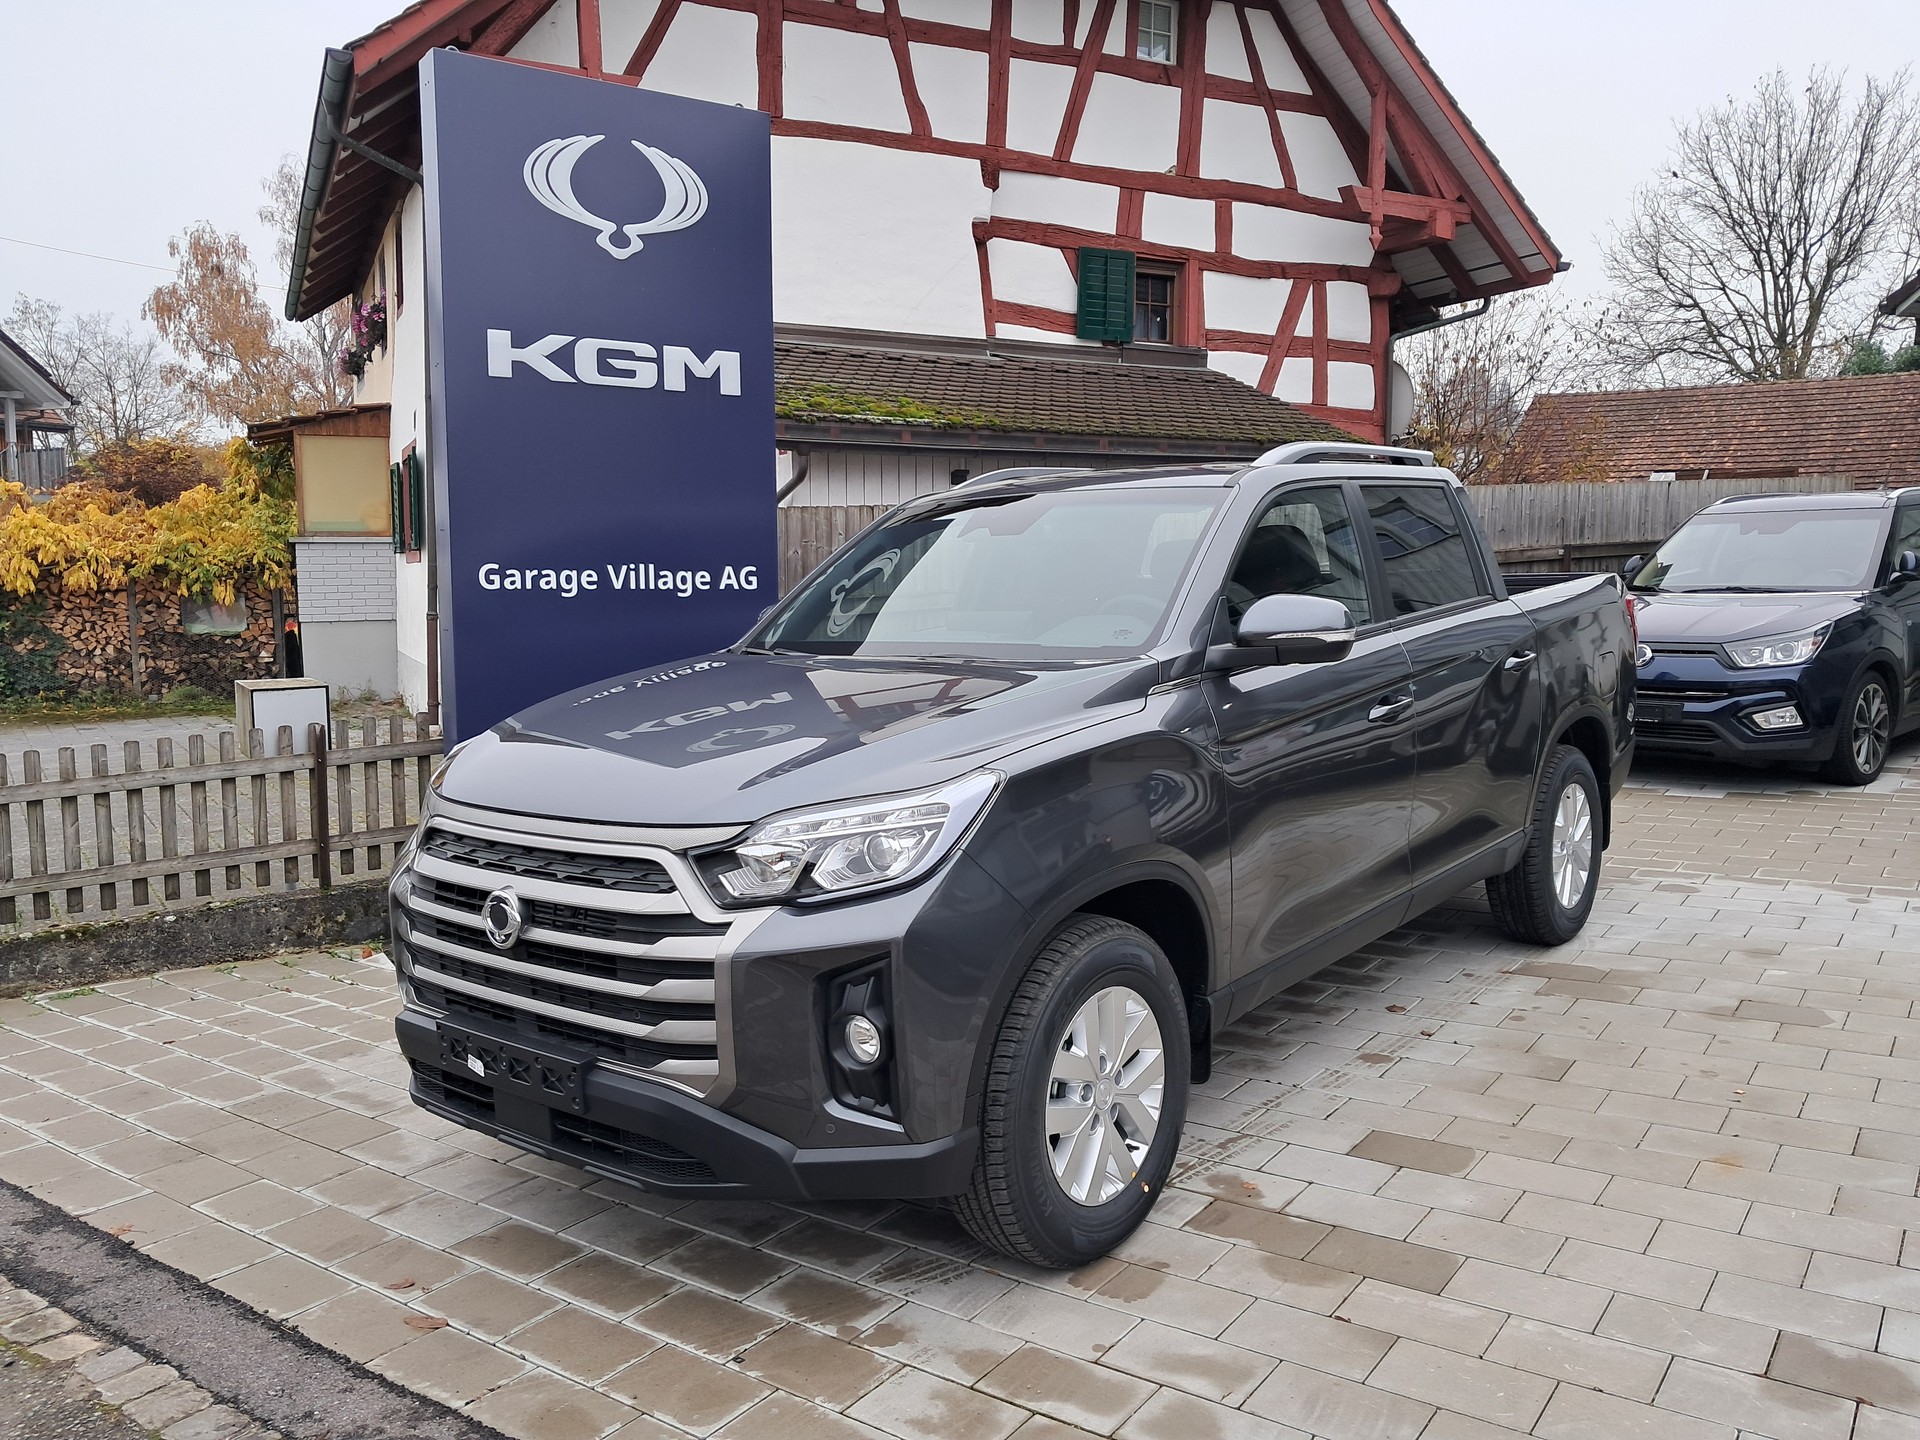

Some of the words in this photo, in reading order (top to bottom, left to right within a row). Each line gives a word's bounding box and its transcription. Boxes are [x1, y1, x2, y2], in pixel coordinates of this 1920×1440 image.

[486, 328, 742, 396] KGM
[478, 563, 599, 597] Garage
[607, 563, 711, 597] Village
[719, 565, 758, 590] AG
